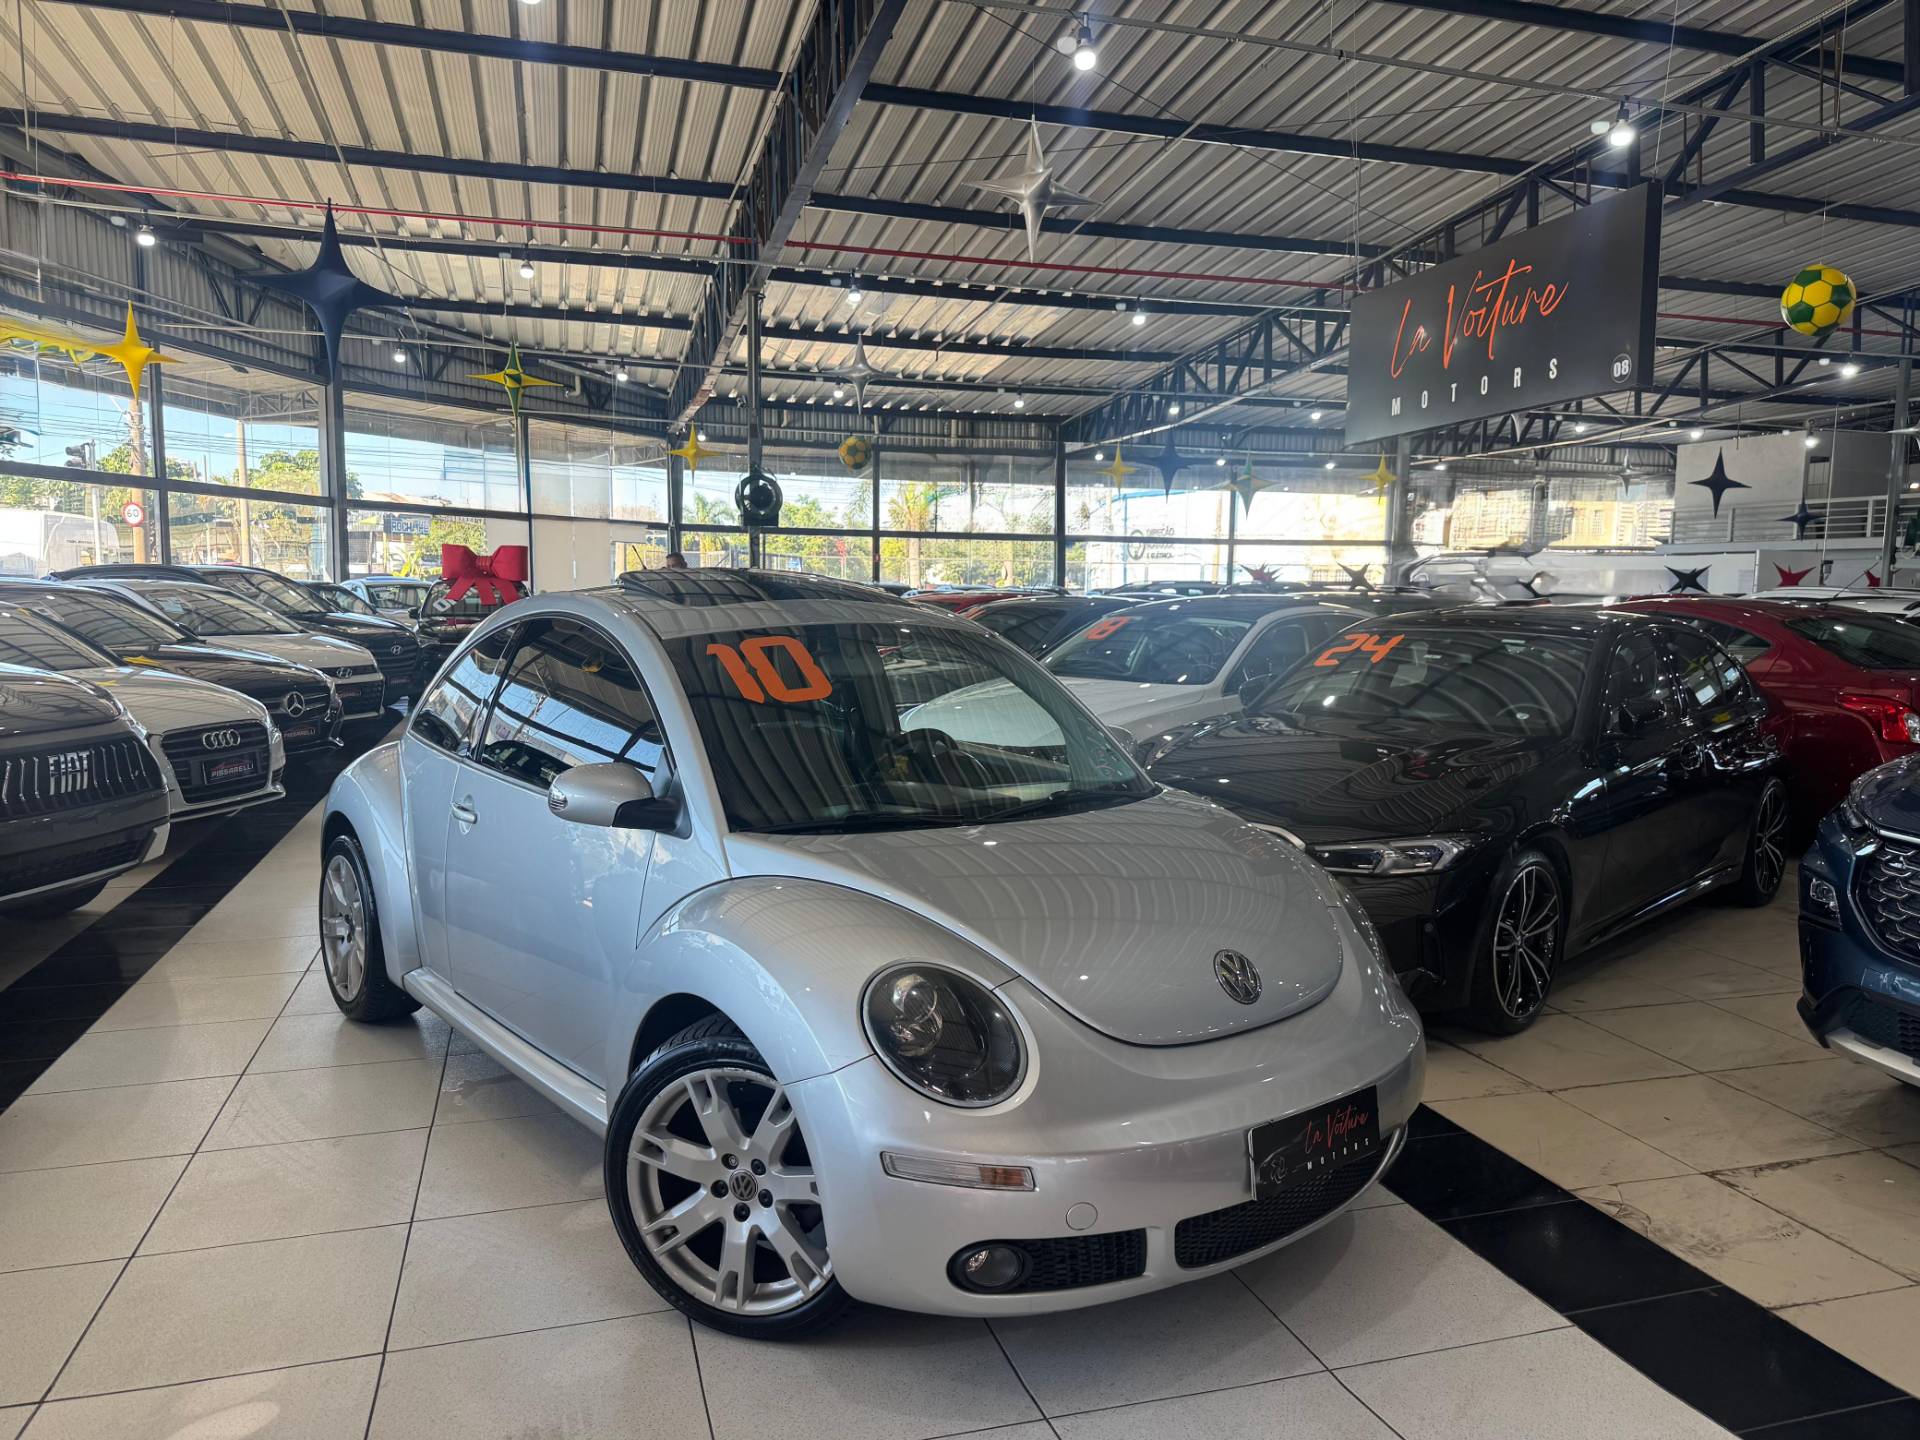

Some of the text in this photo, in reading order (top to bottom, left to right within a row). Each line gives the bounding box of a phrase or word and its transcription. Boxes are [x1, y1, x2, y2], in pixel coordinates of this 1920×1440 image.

[1391, 258, 1570, 379] La Voiture
[1391, 357, 1558, 417] MOTORS
[1613, 359, 1630, 378] 08
[127, 508, 139, 518] 60
[706, 635, 833, 704] 10
[1313, 633, 1405, 667] 24
[47, 750, 90, 796] FIAT
[1326, 1104, 1369, 1149] Voiture
